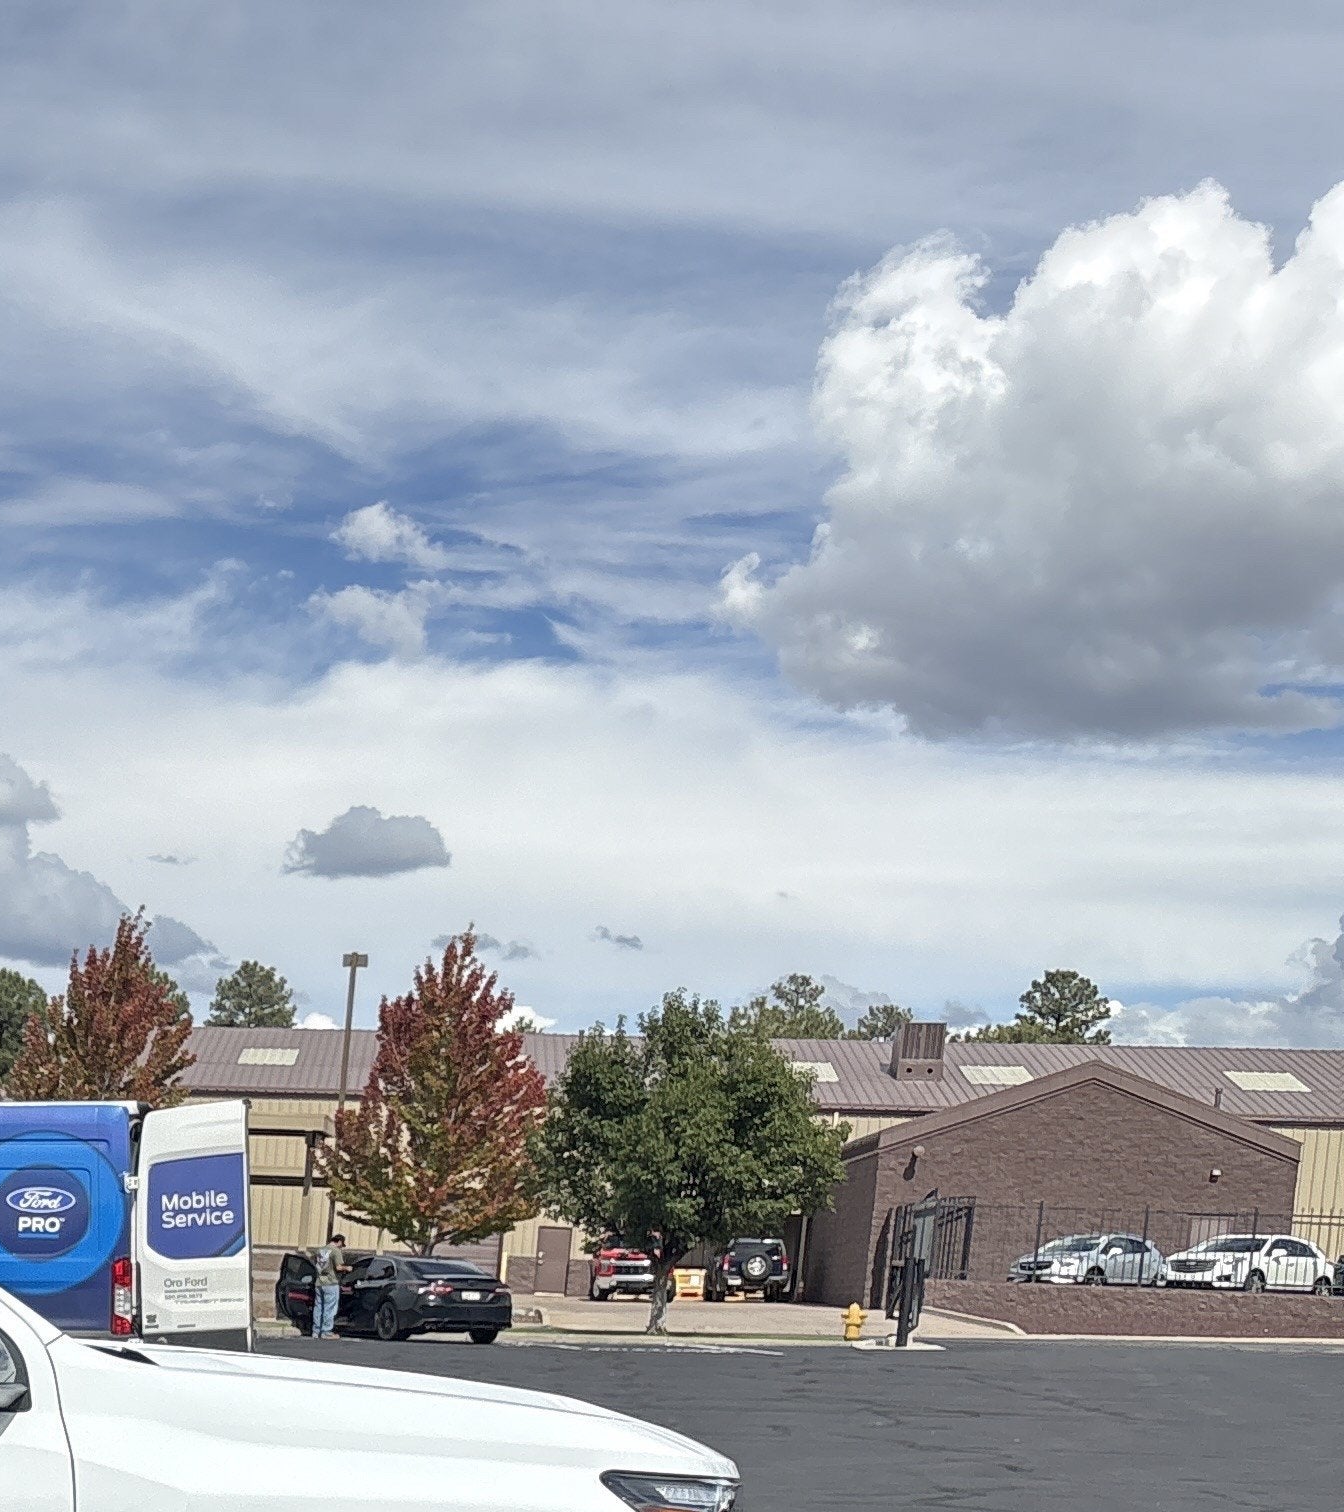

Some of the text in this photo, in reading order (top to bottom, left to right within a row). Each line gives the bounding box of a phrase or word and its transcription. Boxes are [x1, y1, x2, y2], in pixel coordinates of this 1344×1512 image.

[18, 1190, 63, 1209] Ford
[161, 1190, 228, 1212] Mobile
[161, 1209, 234, 1229] Service
[185, 1277, 208, 1287] Ford
